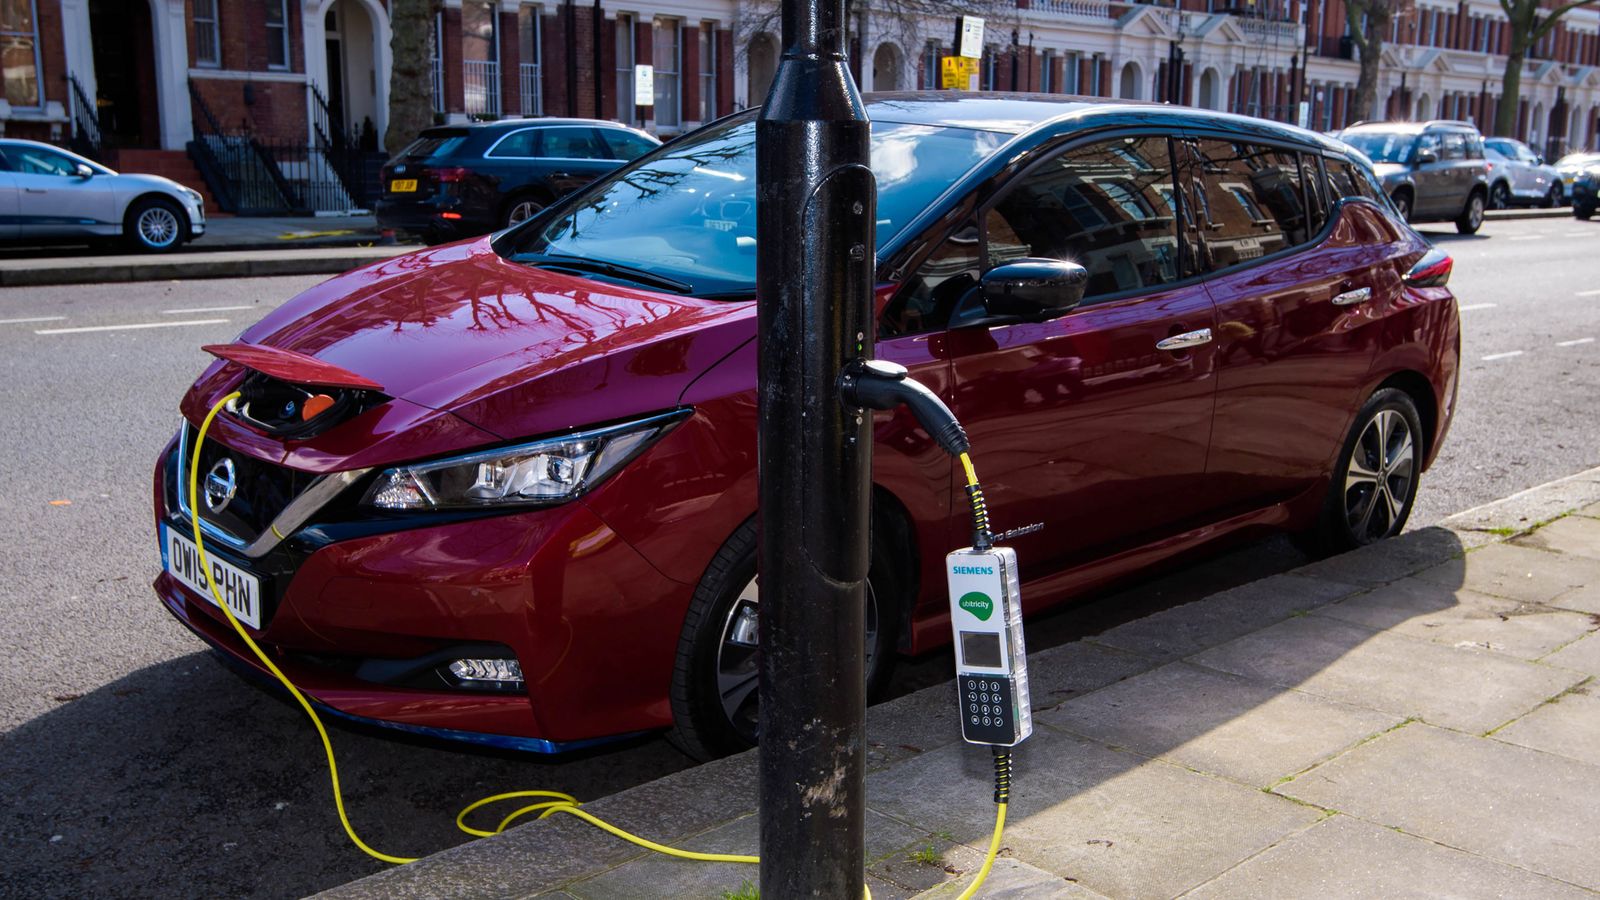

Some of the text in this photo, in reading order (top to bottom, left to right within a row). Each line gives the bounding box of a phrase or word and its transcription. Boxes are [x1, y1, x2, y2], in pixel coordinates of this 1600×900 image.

[953, 566, 993, 575] SIEMENS
[213, 561, 251, 617] PHN
[962, 600, 989, 610] ubitricity
